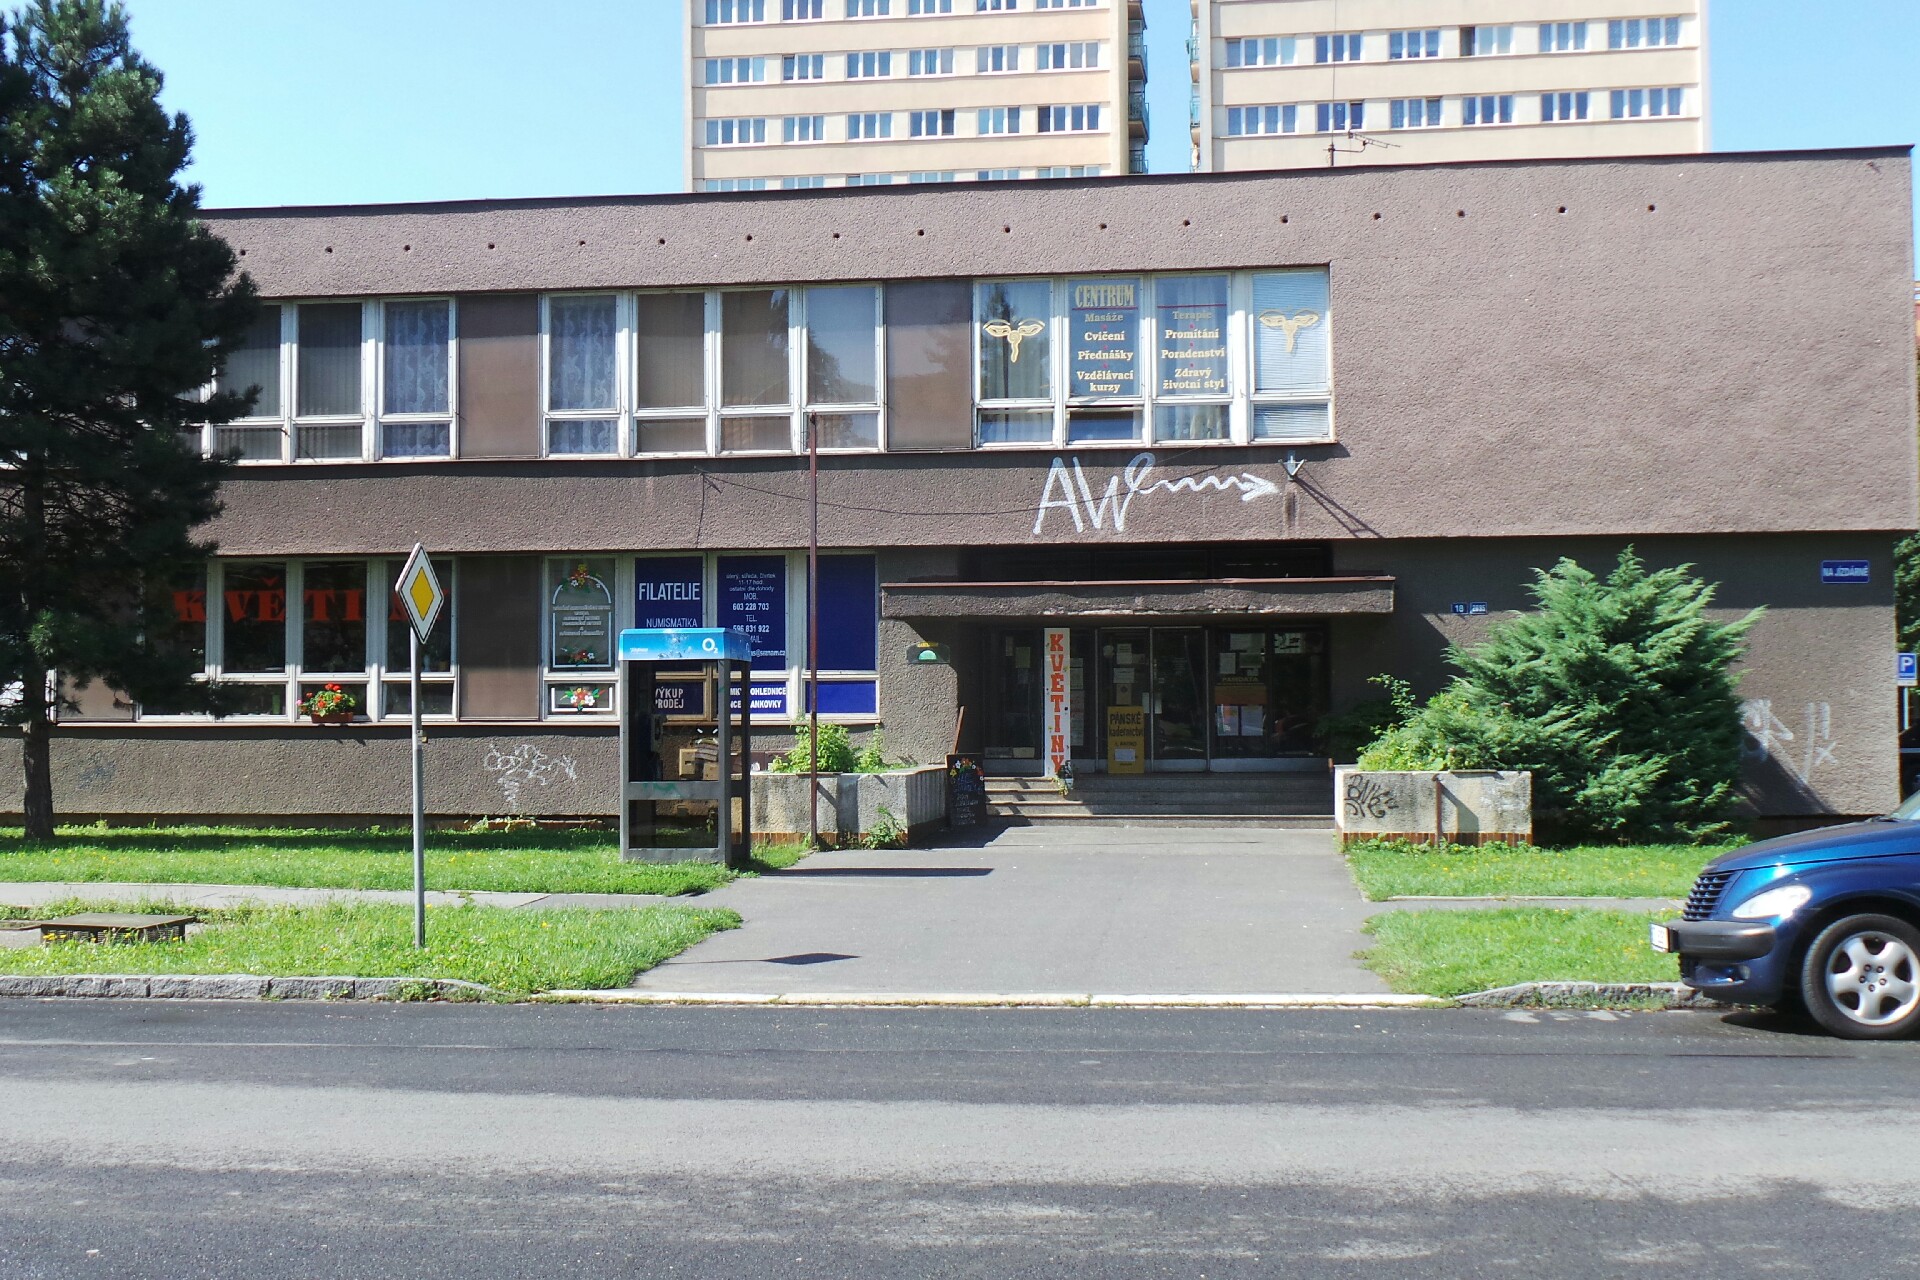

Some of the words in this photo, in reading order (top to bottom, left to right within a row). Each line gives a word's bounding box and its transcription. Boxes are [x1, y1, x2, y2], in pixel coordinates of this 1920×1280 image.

[1075, 285, 1134, 308] CENTRUM
[1085, 313, 1123, 322] Masáže
[1172, 310, 1212, 321] Terapie
[1084, 331, 1125, 341] Cvičení
[1164, 328, 1219, 339] Promítání
[1078, 349, 1133, 361] Přednášky
[1161, 347, 1225, 359] Poradenství
[1077, 370, 1134, 380] Vzdělávací
[1174, 367, 1212, 379] Zdravý
[1089, 382, 1120, 394] kurzy
[1162, 379, 1201, 390] životní
[1203, 378, 1225, 390] styl
[1822, 567, 1834, 577] NA
[638, 582, 701, 601] FILATELIE
[743, 592, 758, 600] MOB.
[732, 603, 744, 611] 603
[745, 603, 757, 611] 228
[758, 603, 770, 611] 703
[1454, 604, 1464, 612] 18
[646, 617, 698, 628] NUMISMATIKA
[745, 614, 757, 622] TEL.
[745, 625, 757, 633] 831
[758, 625, 770, 633] 922
[1901, 656, 1914, 672] P
[1050, 633, 1065, 774] KVĚTINY
[1110, 712, 1141, 725] PÁNSKÉ
